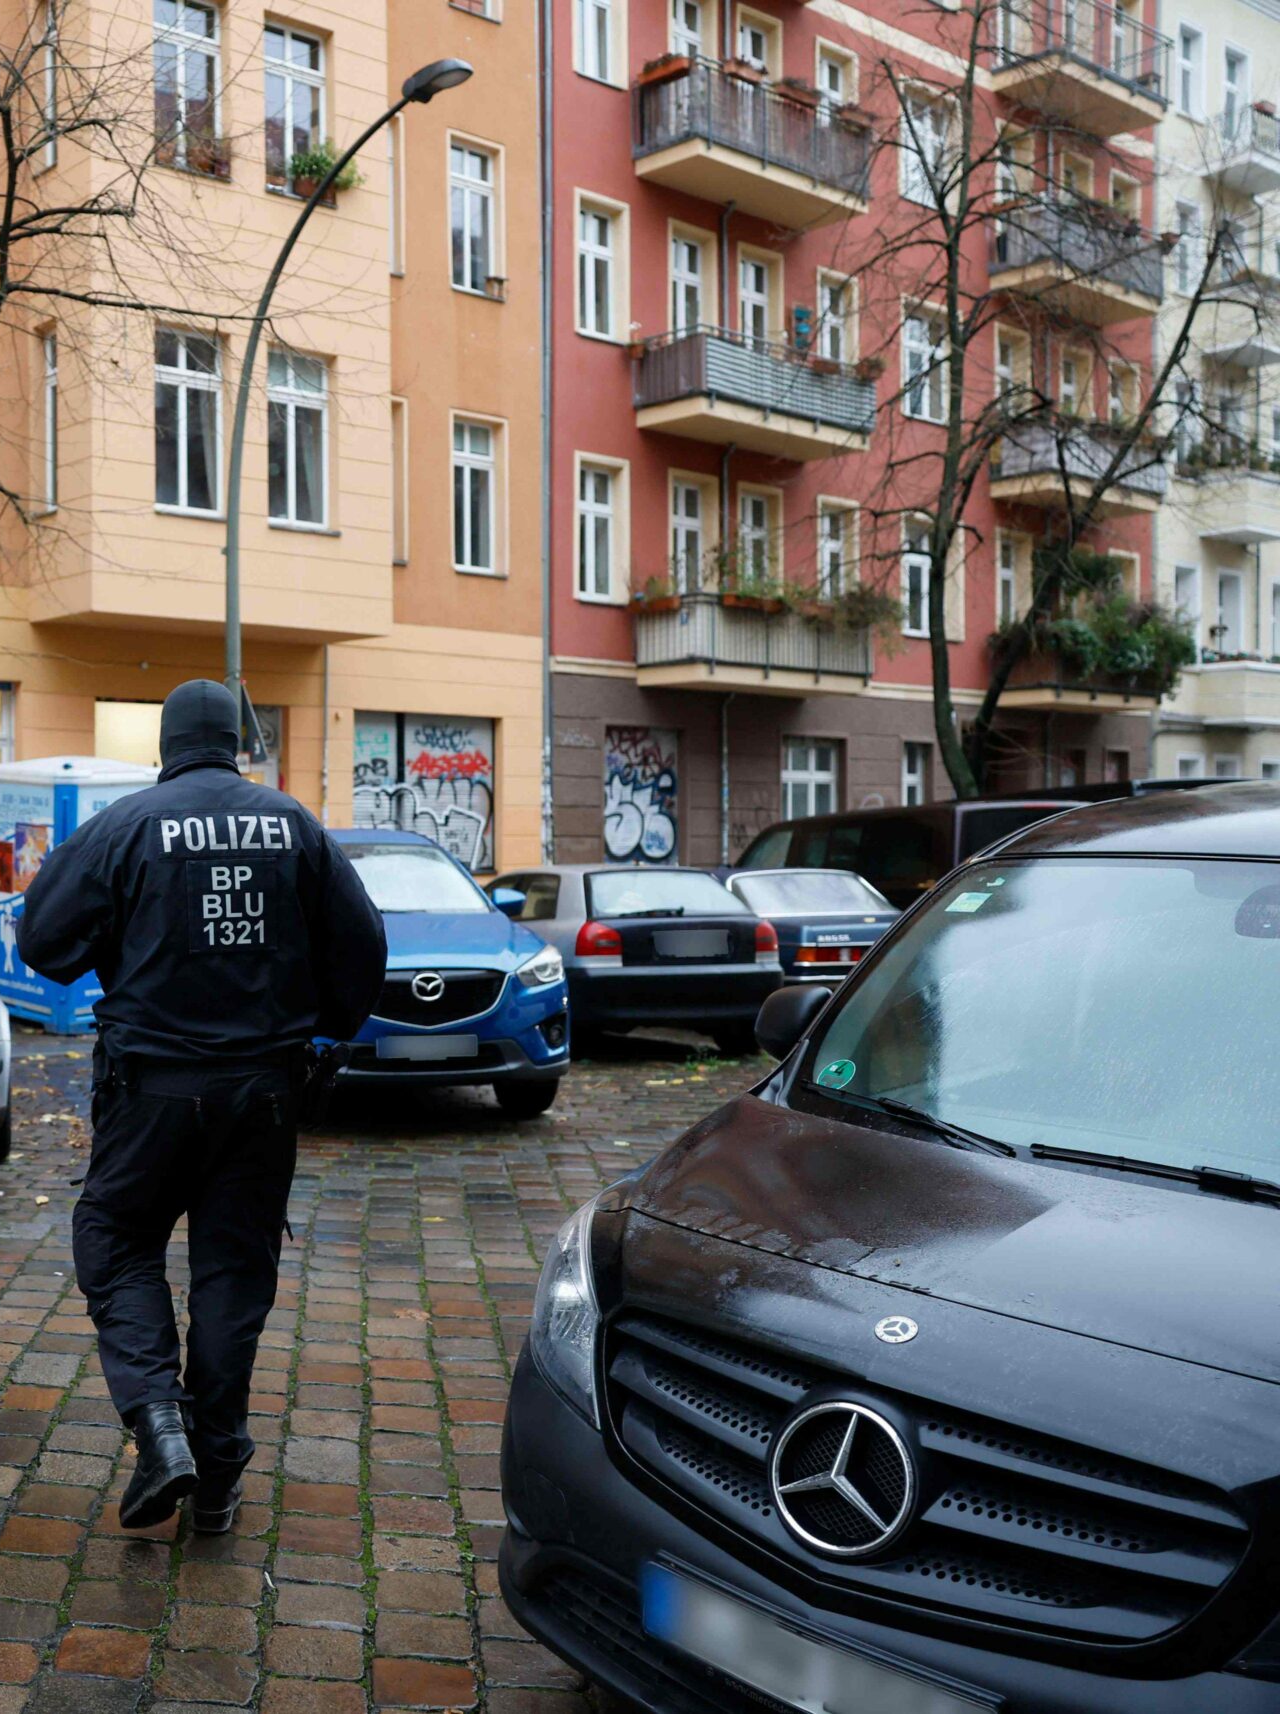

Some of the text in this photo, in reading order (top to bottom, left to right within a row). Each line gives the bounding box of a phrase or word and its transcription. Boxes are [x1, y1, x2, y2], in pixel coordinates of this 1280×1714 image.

[160, 815, 292, 853] POLIZEI
[210, 865, 253, 891] BP
[202, 892, 264, 919] BLU
[203, 919, 265, 946] 1321
